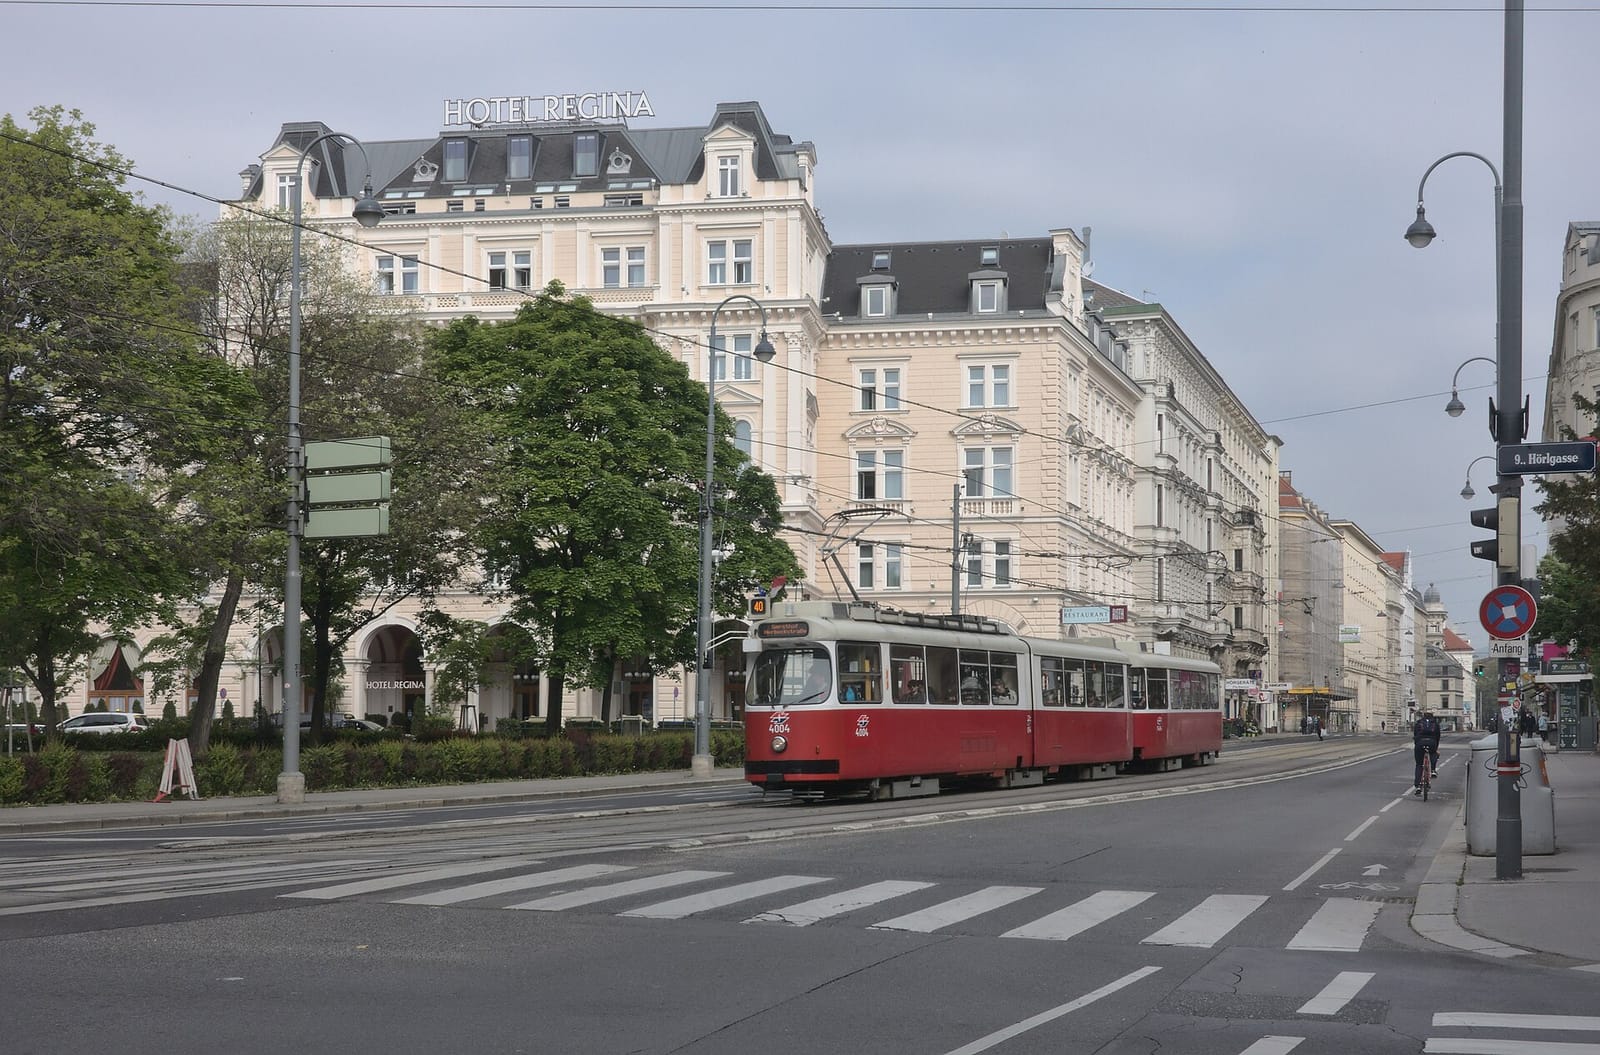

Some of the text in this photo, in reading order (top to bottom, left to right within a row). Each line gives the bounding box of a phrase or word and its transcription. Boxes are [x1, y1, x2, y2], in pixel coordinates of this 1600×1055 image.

[443, 89, 656, 126] HOTEL REGINA
[1528, 452, 1579, 466] Hörlgasse
[753, 600, 764, 612] 40
[1063, 611, 1108, 619] RESTAURANT
[1492, 643, 1523, 656] Anfang
[366, 680, 425, 689] HOTEL REGINA
[768, 723, 791, 734] 4004
